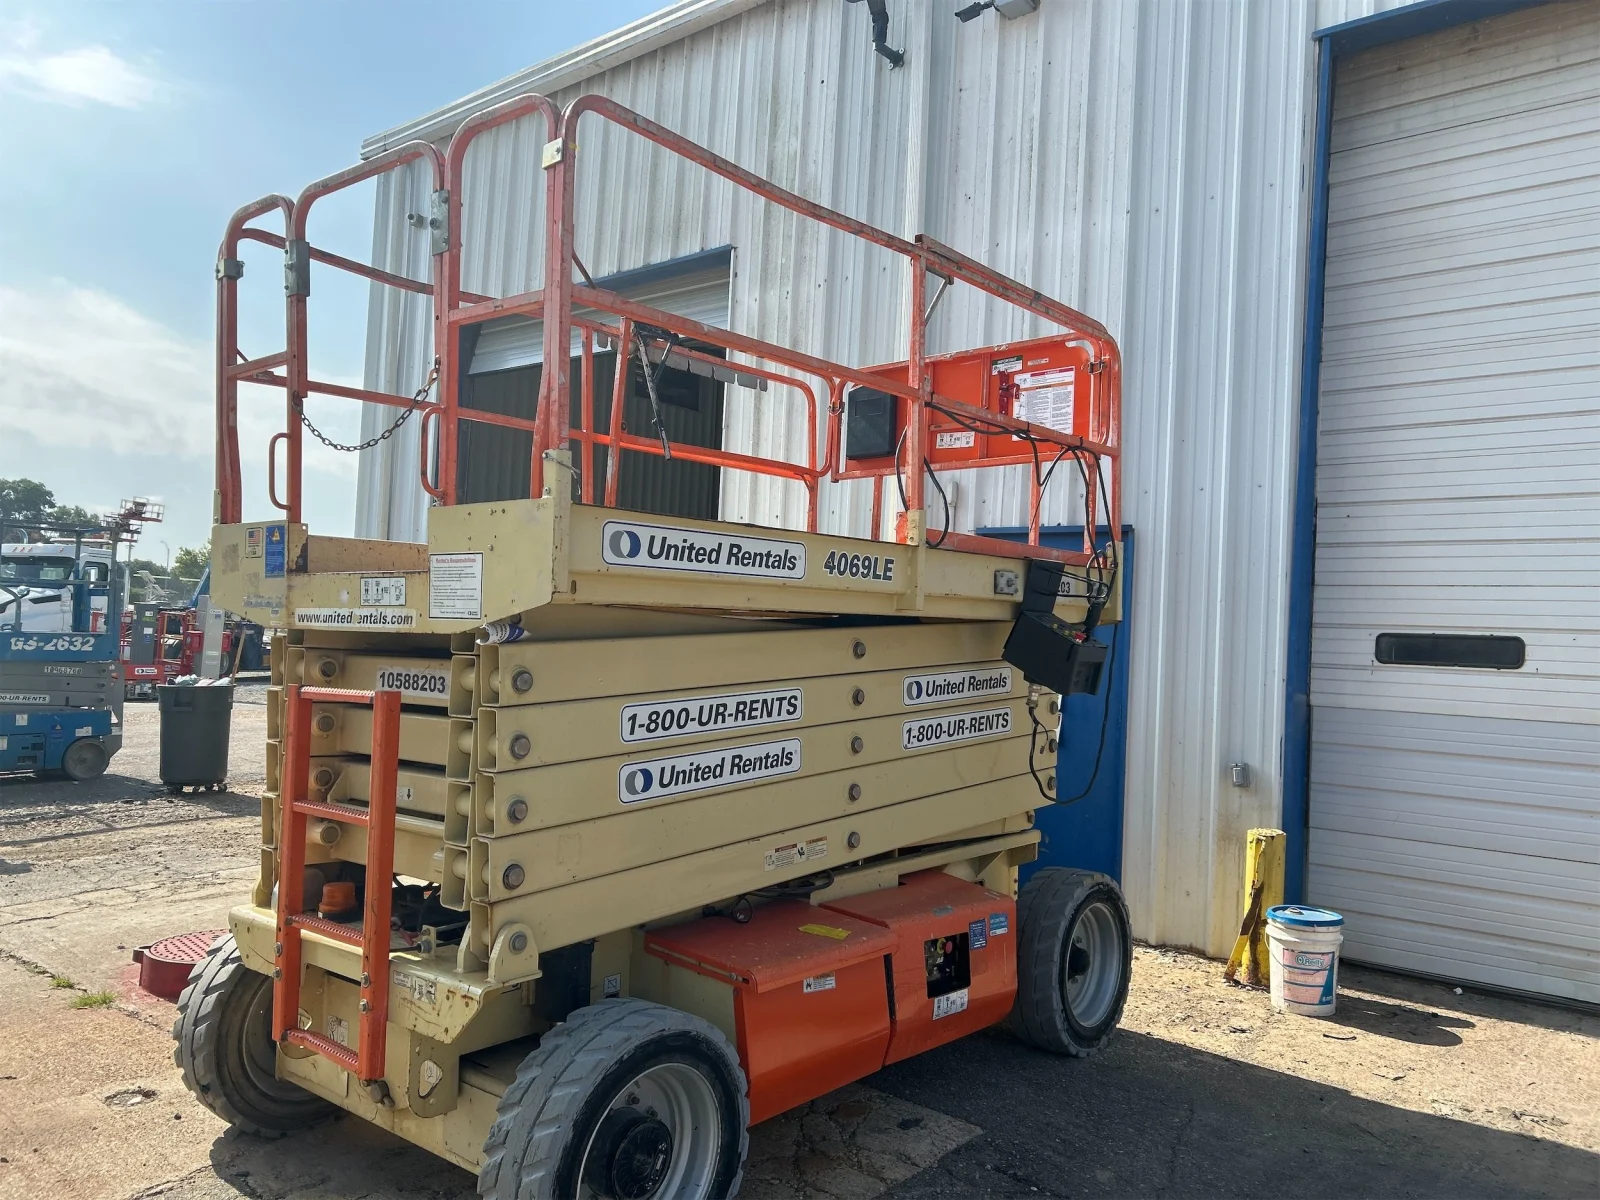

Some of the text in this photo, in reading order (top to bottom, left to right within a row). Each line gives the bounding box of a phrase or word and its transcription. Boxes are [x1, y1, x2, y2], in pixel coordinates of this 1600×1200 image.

[647, 534, 797, 571] United Rentals
[823, 550, 895, 582] 4069LE
[297, 610, 413, 625] www.unitedentals.com
[10, 636, 95, 651] GS-2632
[379, 671, 446, 694] 10588203
[925, 672, 1008, 698] United Rentals
[627, 694, 799, 736] 1-800-UR-RENTS
[905, 712, 1009, 744] 1-800-UR-RENTS
[657, 746, 794, 789] United Rentals
